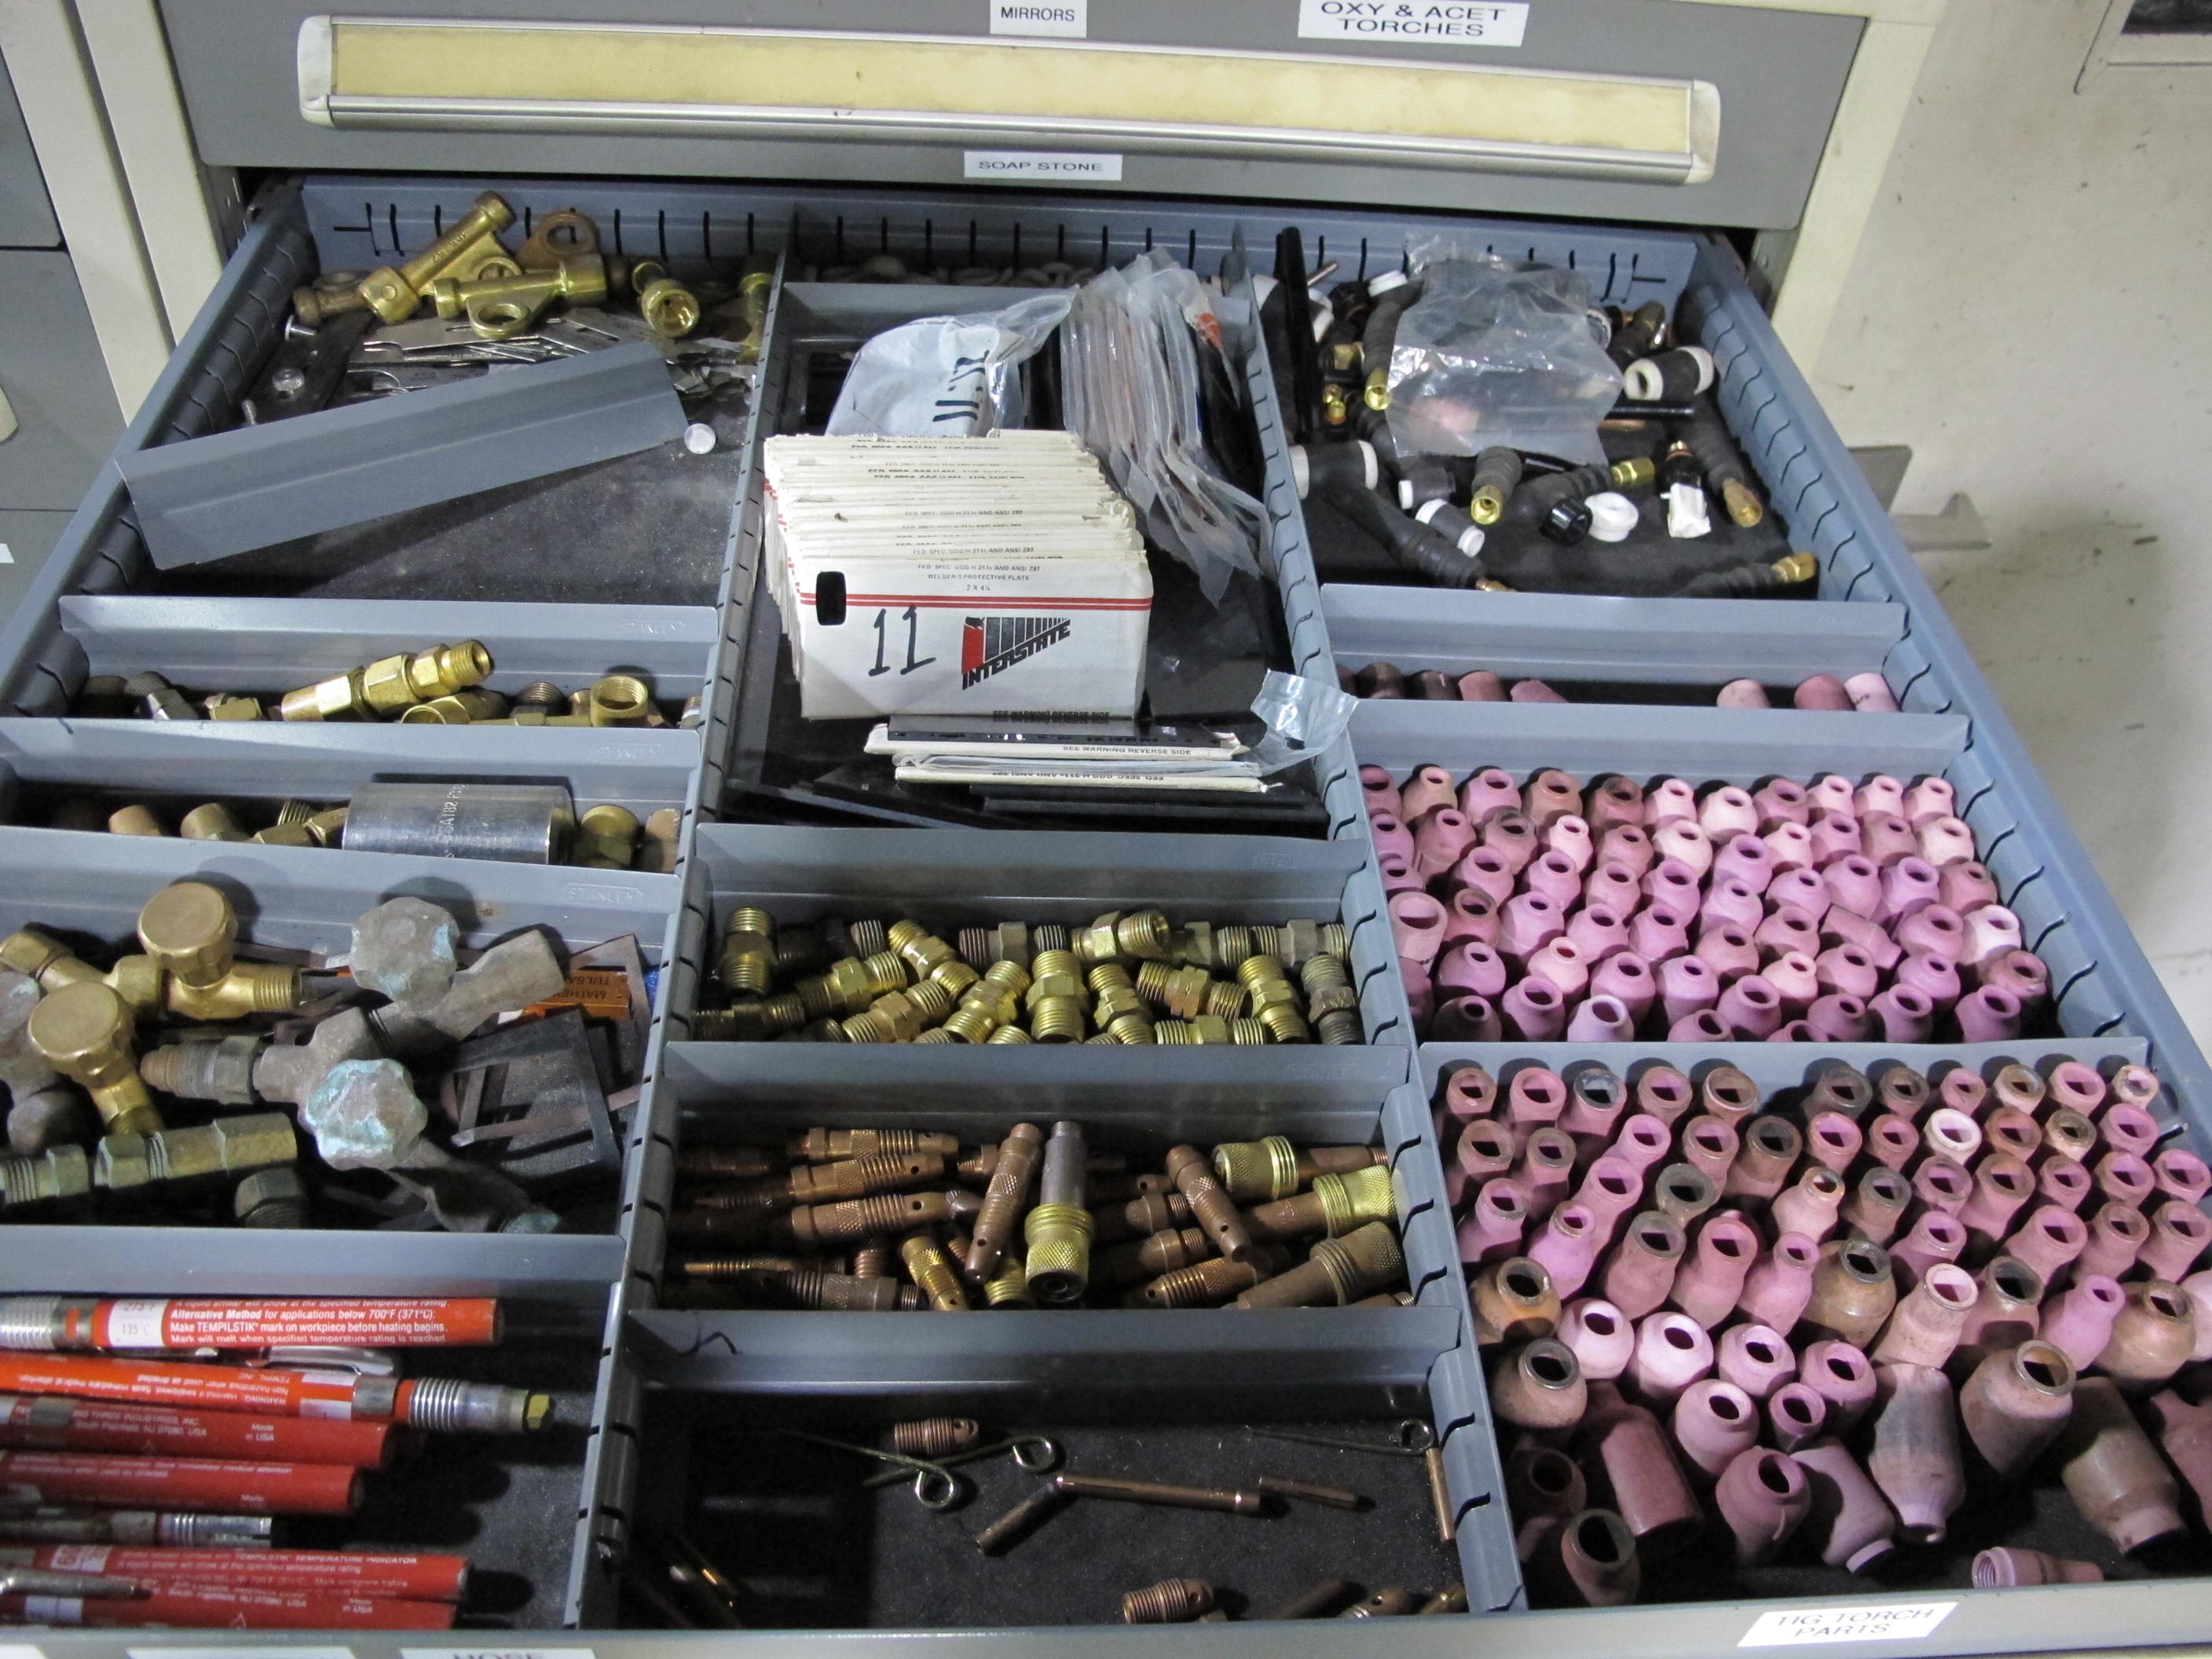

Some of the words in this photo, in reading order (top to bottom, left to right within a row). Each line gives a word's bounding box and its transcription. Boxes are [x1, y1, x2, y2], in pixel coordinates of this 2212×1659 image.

[1001, 6, 1075, 22] MIRRORS
[1321, 1, 1385, 16] OXY
[1394, 5, 1413, 17] &
[1425, 6, 1506, 20] ACET
[1337, 18, 1484, 37] TORCHES
[979, 161, 1031, 170] SOAP
[1038, 163, 1103, 171] STONE
[962, 618, 1071, 691] INTERSTATE
[993, 709, 1009, 718] SEE
[1011, 710, 1050, 719] WARNING
[1053, 710, 1090, 720] REVERSE
[363, 1300, 419, 1309] temperature
[170, 1309, 225, 1320] Alternative
[226, 1309, 262, 1320] Method
[264, 1309, 278, 1320] for
[280, 1309, 335, 1323] applications
[338, 1309, 366, 1320] below
[368, 1309, 396, 1320] 700°F
[122, 1323, 138, 1335] 135
[170, 1321, 195, 1333] Make
[260, 1322, 285, 1333] mark
[286, 1324, 298, 1333] on
[299, 1322, 346, 1335] workpiece
[347, 1321, 377, 1333] before
[379, 1321, 412, 1335] heating
[170, 1335, 196, 1343] Mark
[197, 1335, 214, 1343] will
[216, 1335, 236, 1343] melt
[266, 1335, 308, 1344] specified
[310, 1335, 367, 1344] temperature
[189, 1426, 207, 1437] USA
[256, 1433, 274, 1441] USA
[353, 1605, 373, 1613] USA
[1778, 1613, 1823, 1626] TIG
[1837, 1609, 1935, 1623] TORCH
[1794, 1623, 1891, 1637] PARTS
